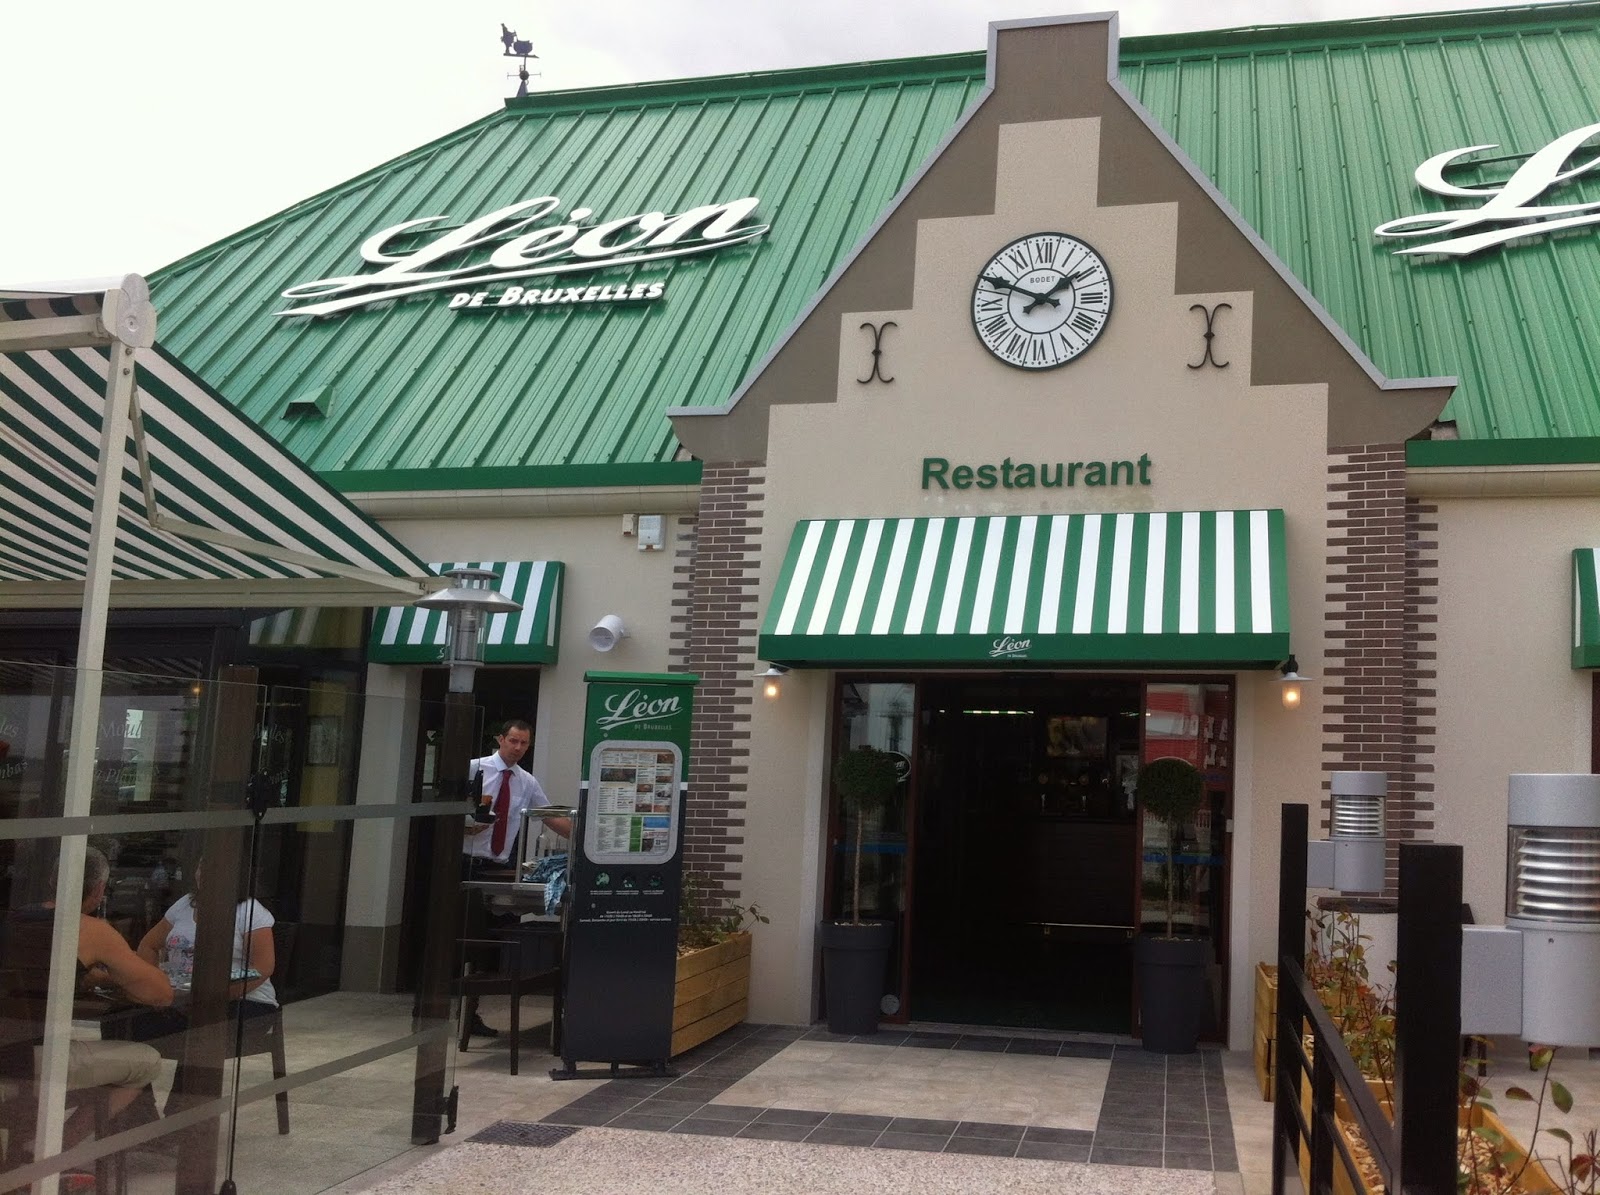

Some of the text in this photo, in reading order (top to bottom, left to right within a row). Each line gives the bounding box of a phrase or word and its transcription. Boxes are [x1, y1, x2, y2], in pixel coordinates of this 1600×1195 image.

[1029, 275, 1056, 284] BODET
[498, 281, 665, 308] BRUXELLES
[921, 452, 1152, 490] Restaurant
